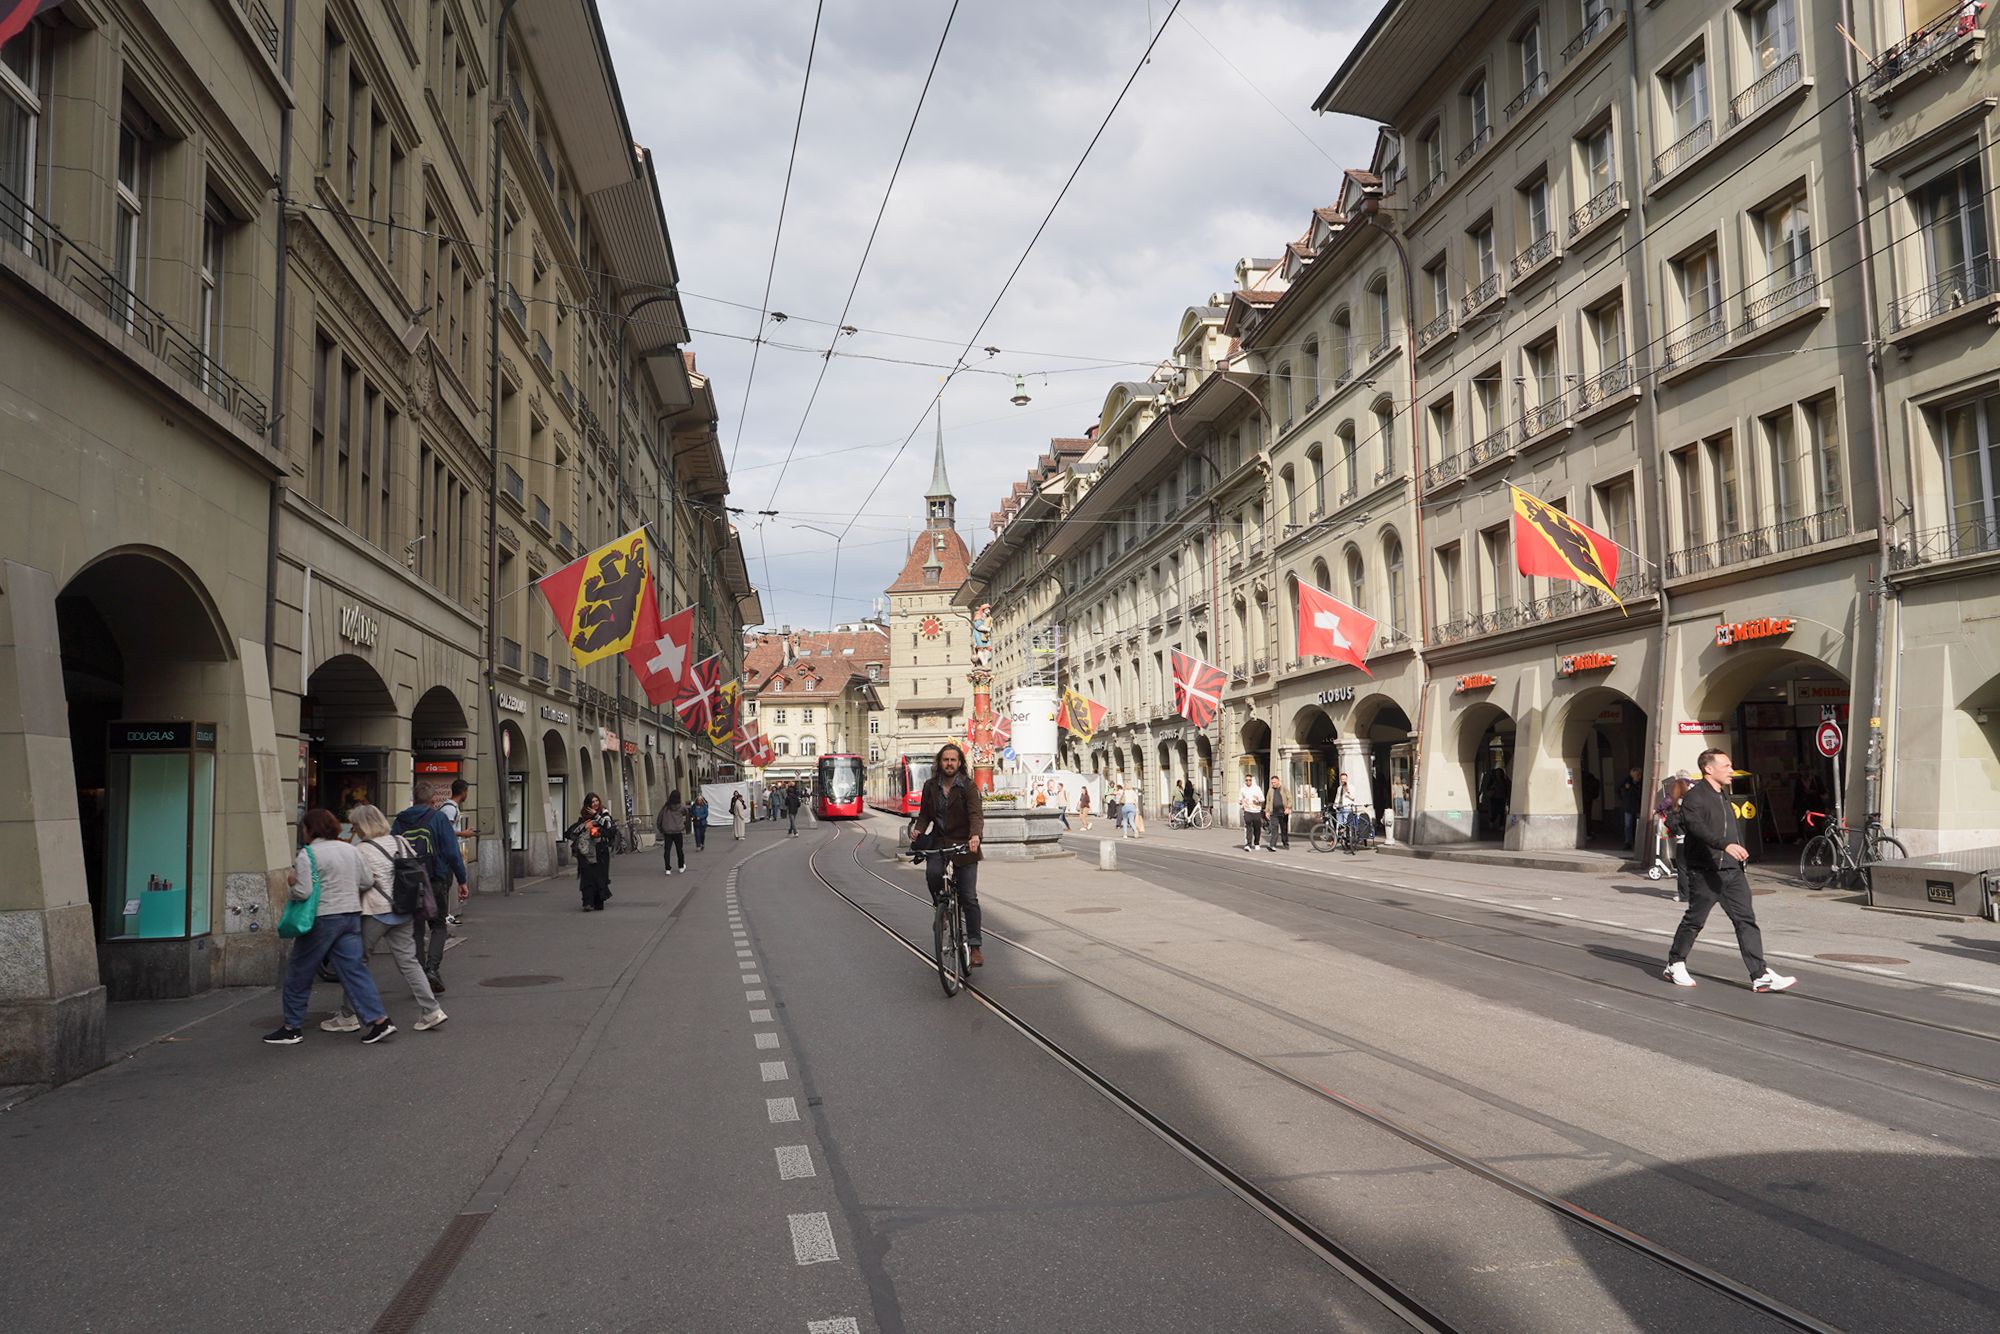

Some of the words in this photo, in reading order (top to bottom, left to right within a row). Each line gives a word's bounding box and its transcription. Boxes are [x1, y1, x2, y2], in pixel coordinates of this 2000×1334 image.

[1733, 617, 1790, 641] Müller
[1574, 653, 1614, 671] Müller
[1464, 673, 1493, 689] Müller
[1318, 686, 1353, 704] GLOBUS
[127, 731, 175, 741] DOUGLAS
